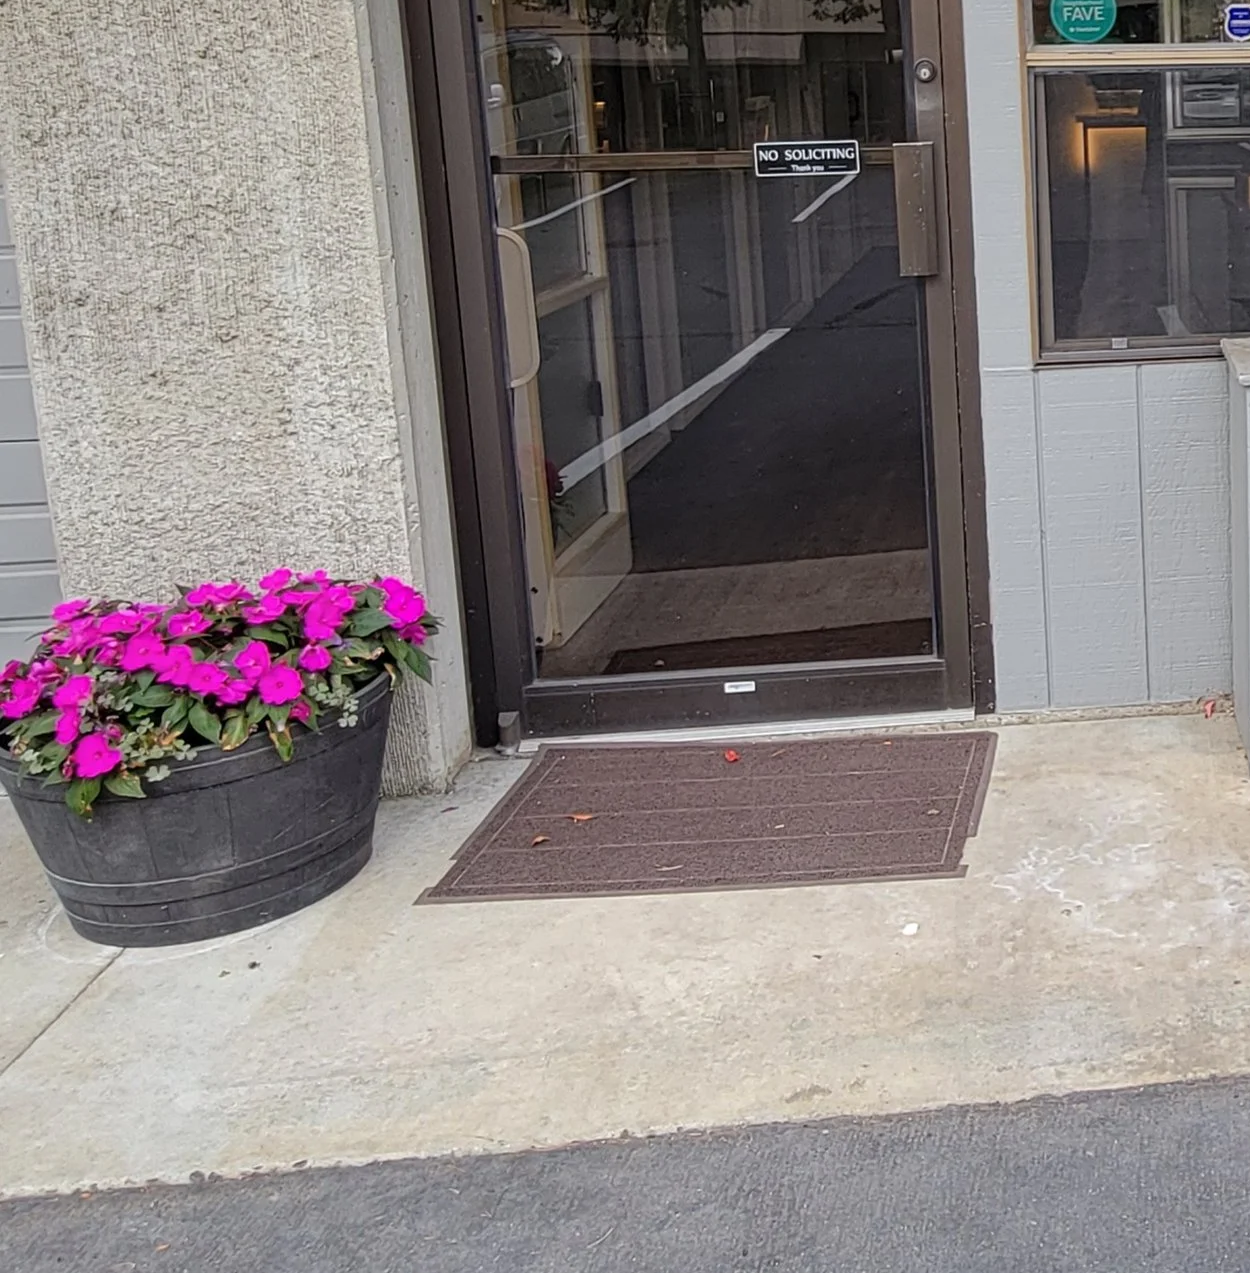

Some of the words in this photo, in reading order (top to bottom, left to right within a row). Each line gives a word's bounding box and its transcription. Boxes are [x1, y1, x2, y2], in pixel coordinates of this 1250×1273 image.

[1062, 6, 1105, 21] FAVE
[758, 150, 779, 162] NO
[784, 148, 855, 161] SOLICITING
